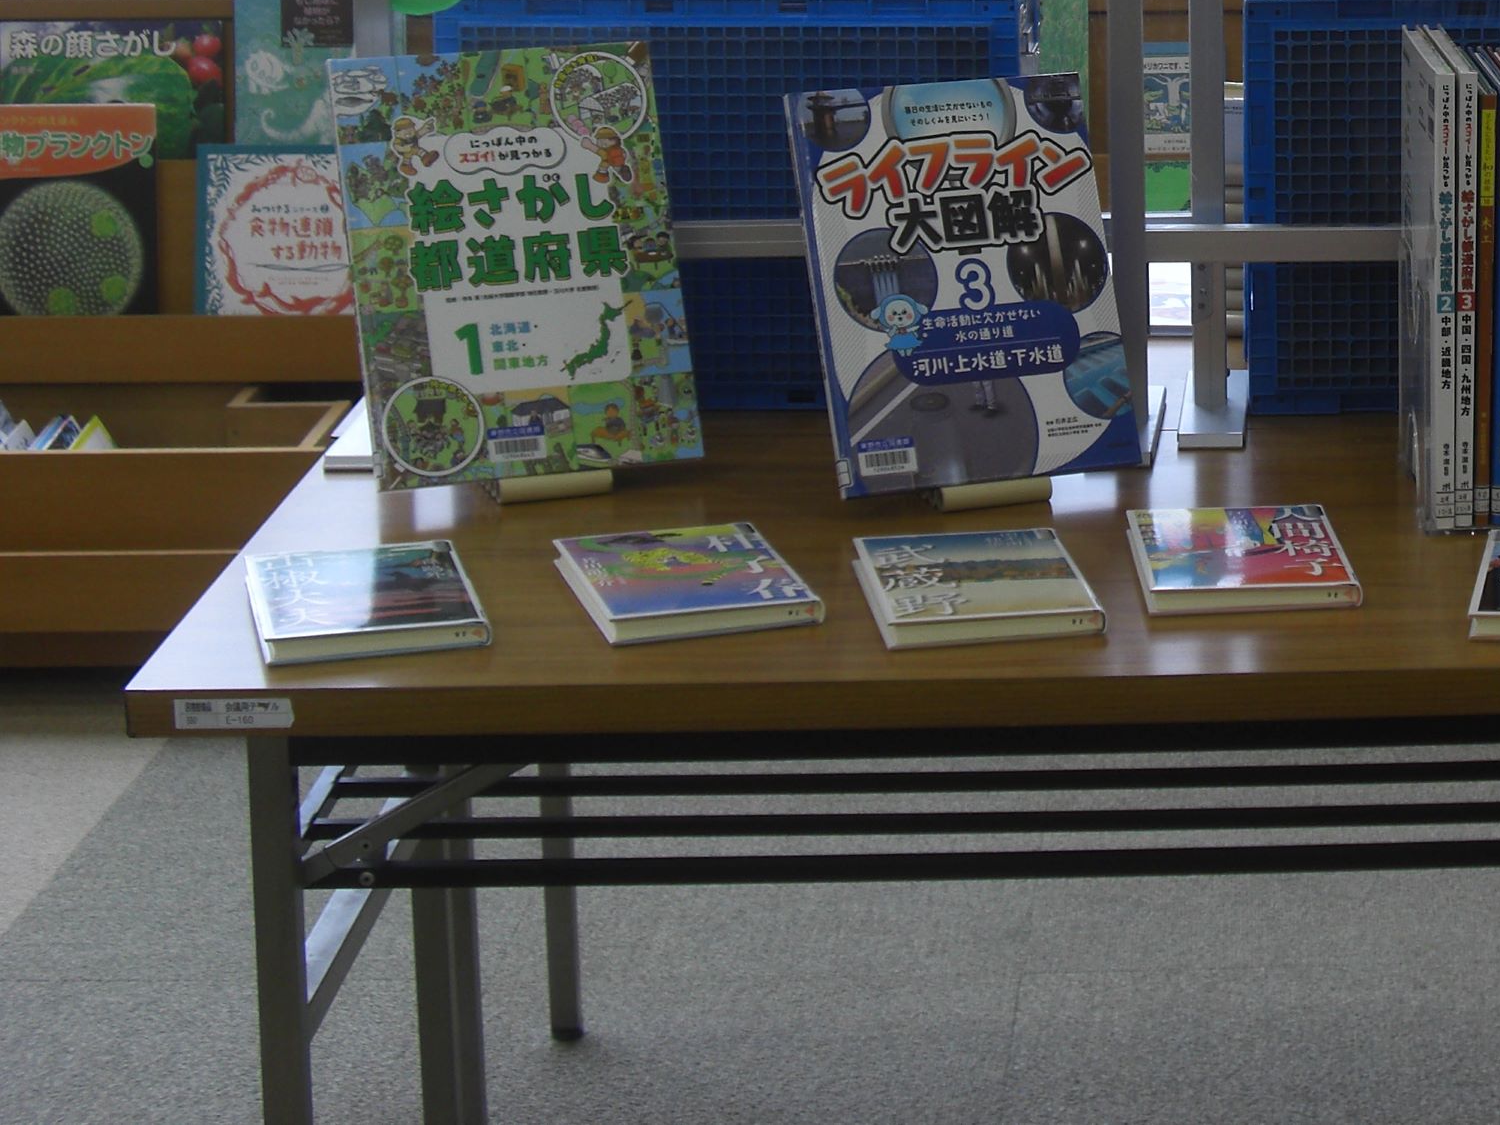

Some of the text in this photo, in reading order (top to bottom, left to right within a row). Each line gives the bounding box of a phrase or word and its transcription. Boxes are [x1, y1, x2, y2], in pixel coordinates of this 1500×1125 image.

[9, 29, 176, 59] 森の顔さがし
[469, 136, 538, 149] にっぽん中の
[819, 132, 1090, 217] ライフライン
[409, 173, 615, 235] 絵さがし
[409, 226, 629, 292] 都道府県
[957, 260, 994, 310] 3
[1441, 295, 1452, 311] 2
[1461, 294, 1473, 310] 3
[454, 323, 485, 375] 1
[912, 344, 1065, 377] 河川・上水道・下水道
[875, 543, 969, 617] 武蔵野
